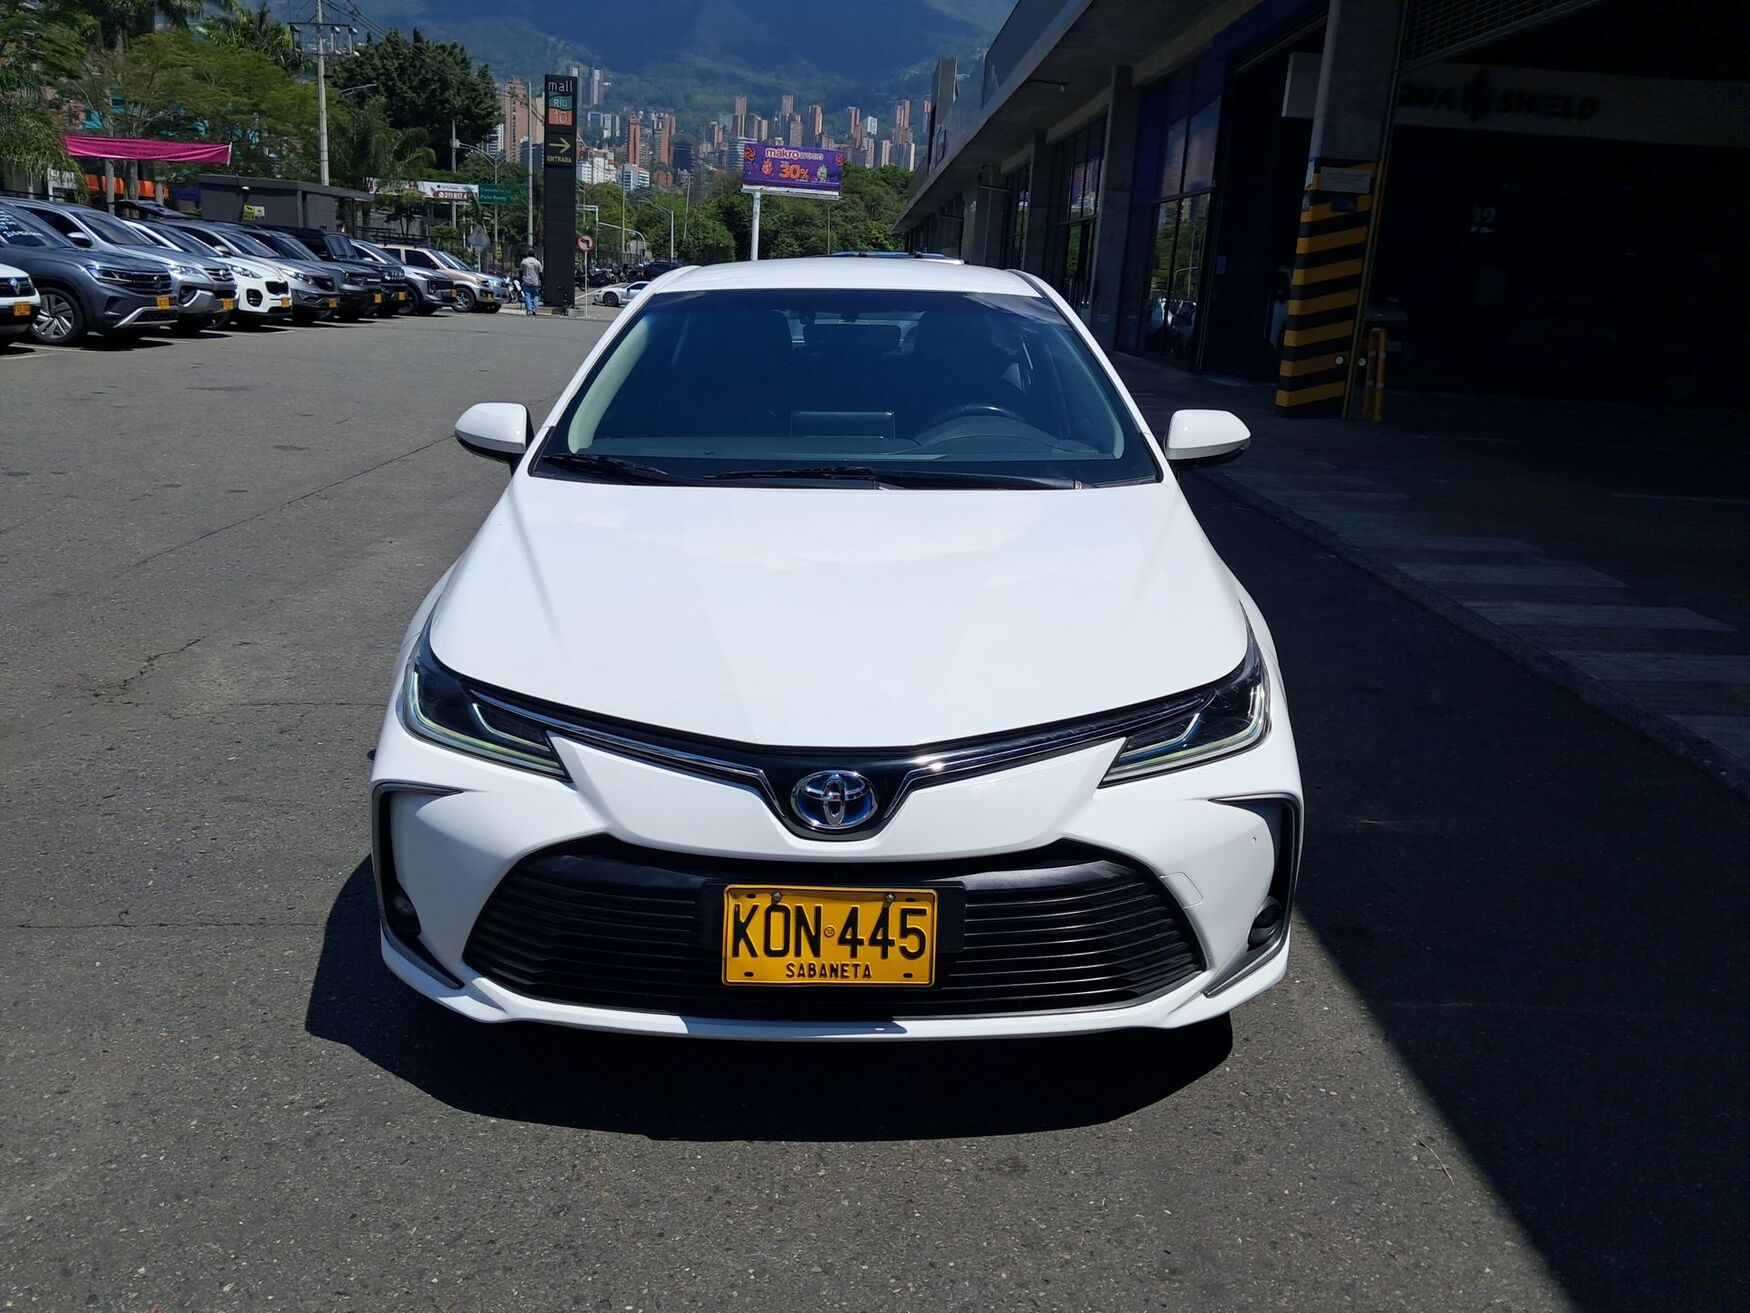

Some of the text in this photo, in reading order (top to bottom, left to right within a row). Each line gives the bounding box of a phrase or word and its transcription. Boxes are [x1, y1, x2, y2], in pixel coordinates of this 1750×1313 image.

[548, 80, 573, 92] mall
[1498, 90, 1600, 119] SHIELD
[547, 155, 571, 163] ENTRADA
[779, 163, 809, 180] 30%
[731, 904, 927, 960] KON 445
[785, 962, 873, 979] SABANETA
